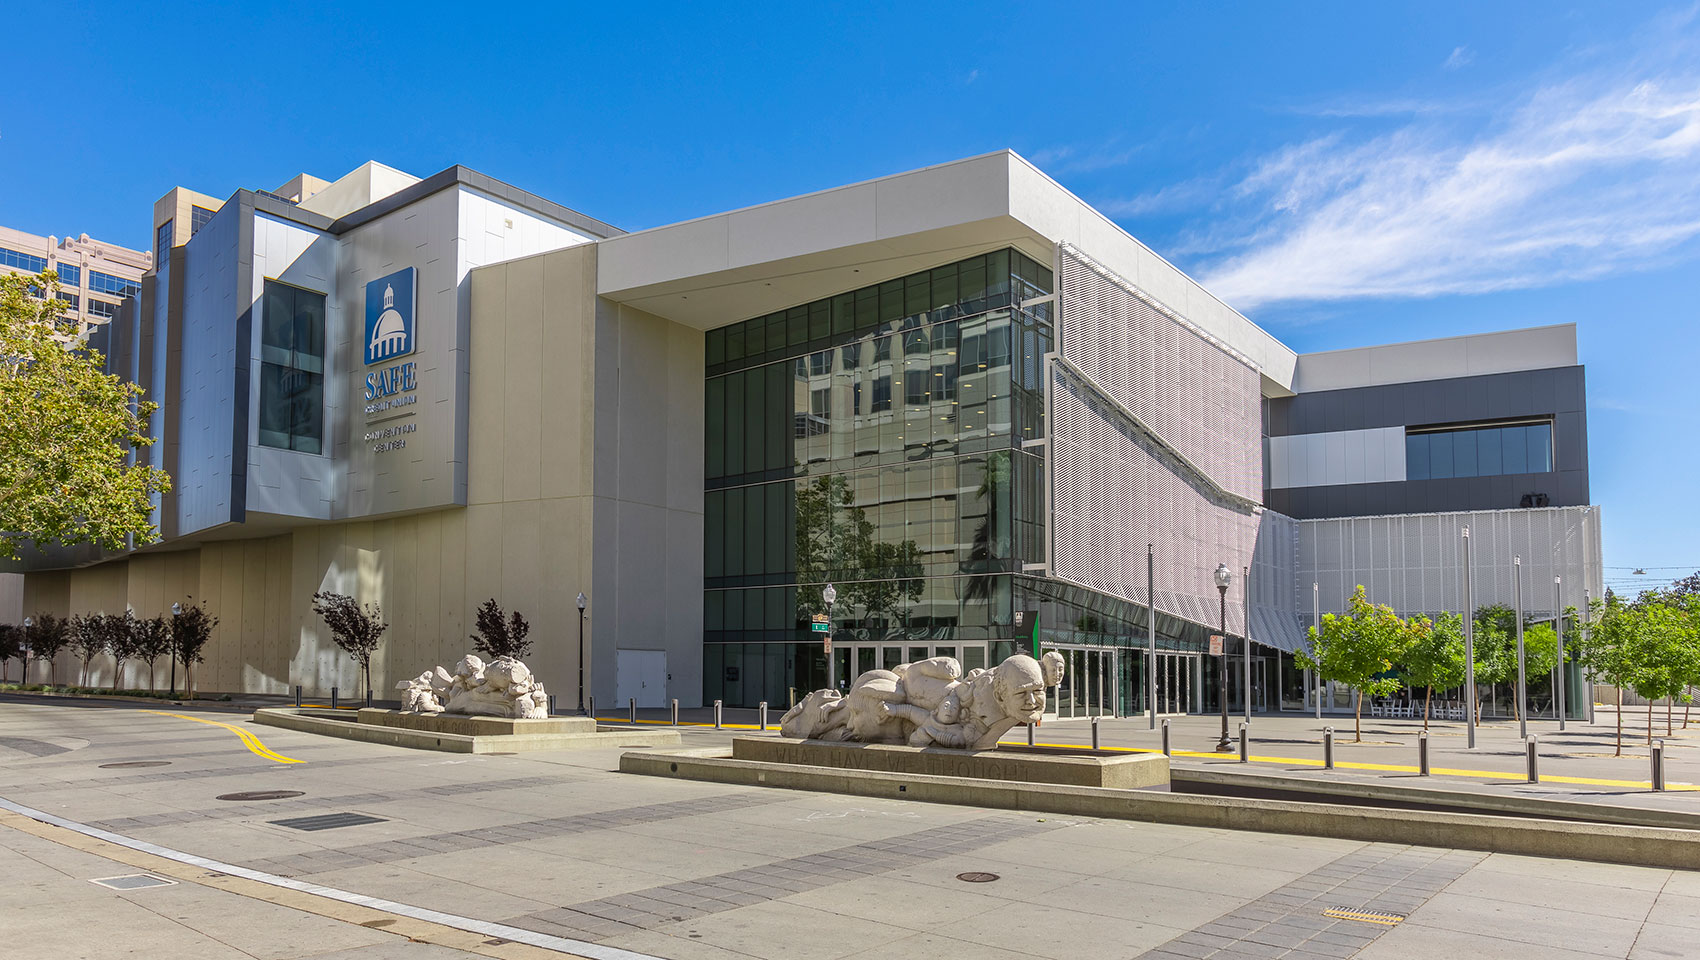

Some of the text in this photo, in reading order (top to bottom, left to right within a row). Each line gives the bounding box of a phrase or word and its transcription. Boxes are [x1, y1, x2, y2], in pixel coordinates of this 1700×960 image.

[365, 362, 417, 401] SAFE
[364, 424, 417, 441] CONVENTION
[373, 439, 406, 453] CENTER
